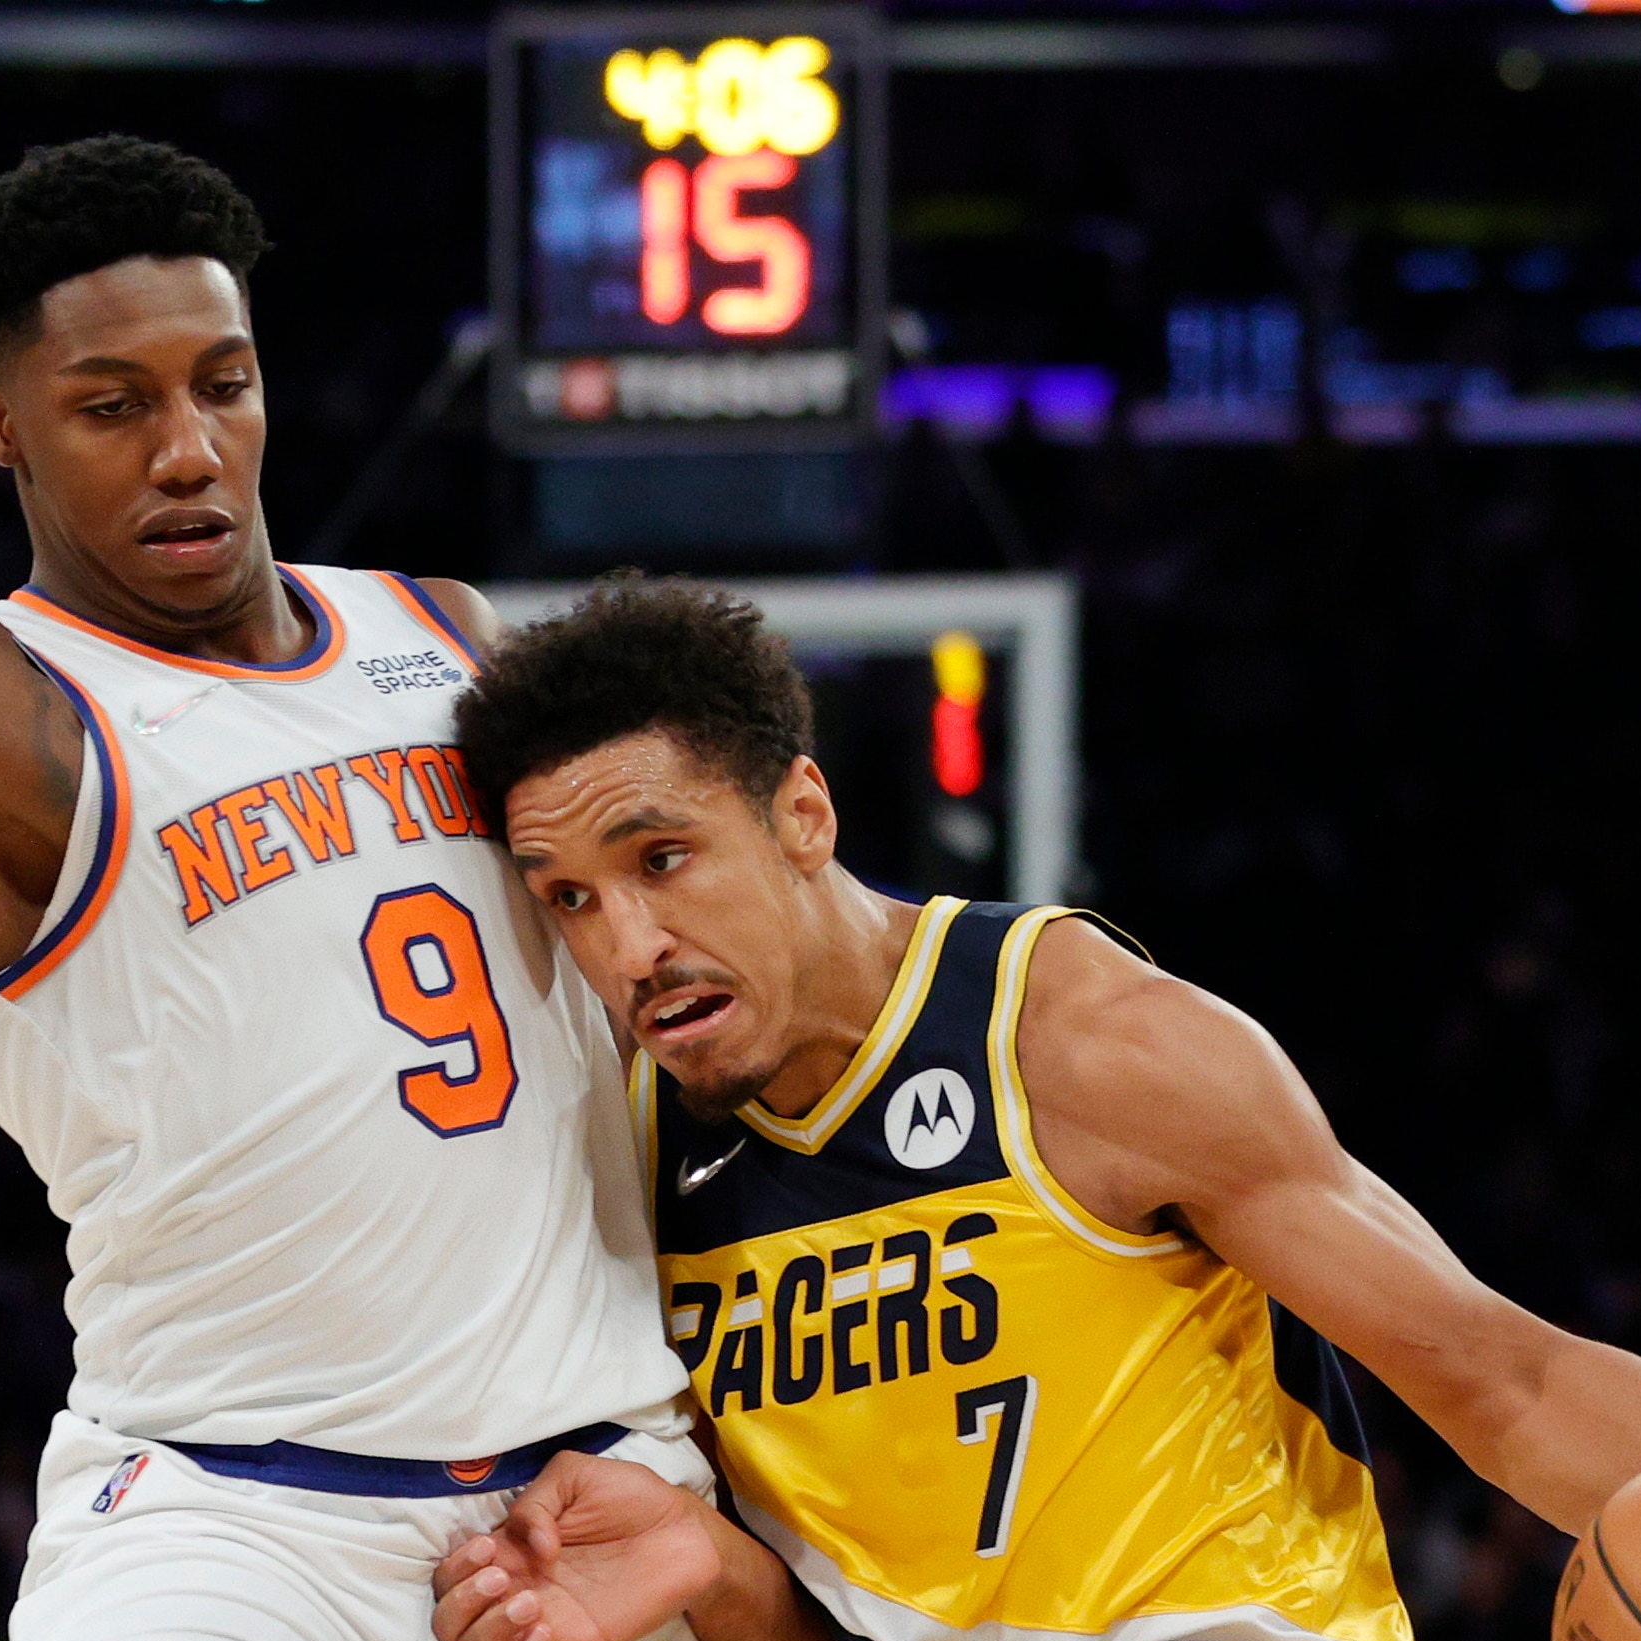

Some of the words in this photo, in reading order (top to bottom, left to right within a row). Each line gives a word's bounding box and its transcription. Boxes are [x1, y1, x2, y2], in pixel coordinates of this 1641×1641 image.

[642, 150, 810, 334] 15
[356, 650, 446, 677] SQUARE
[372, 672, 445, 694] SPACE
[156, 761, 359, 929] NEW
[359, 882, 519, 1140] 9
[671, 1212, 999, 1418] PACERS
[954, 1373, 1038, 1560] 7
